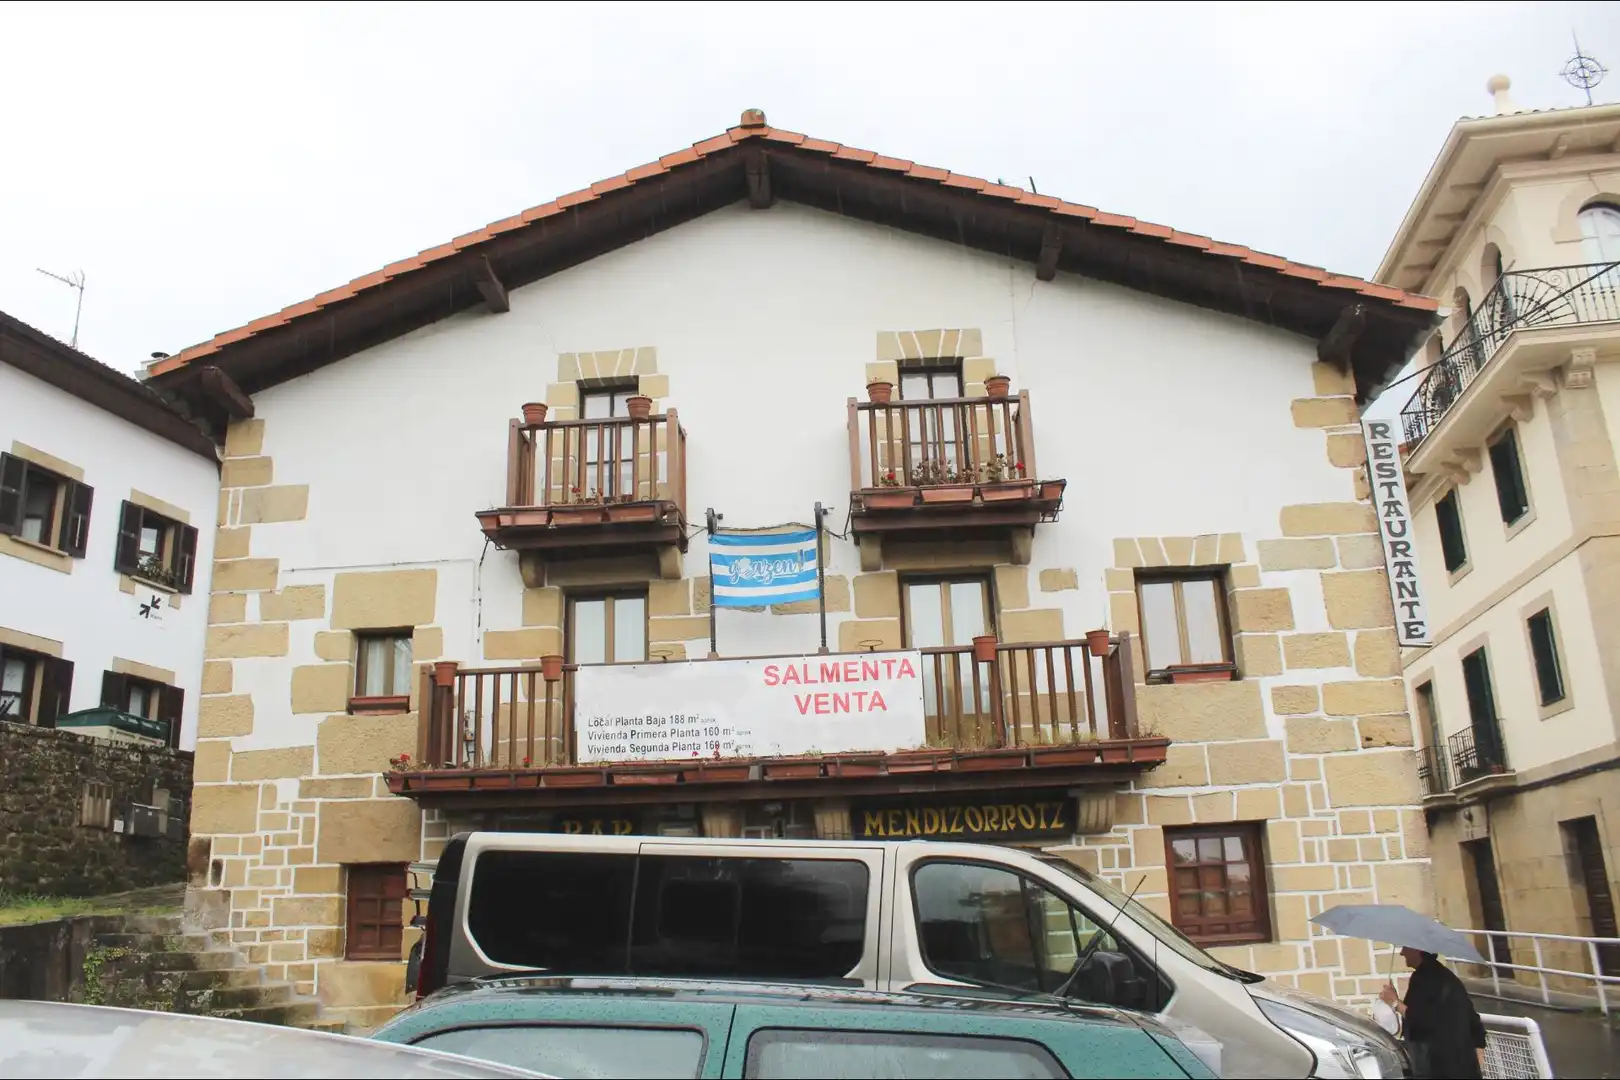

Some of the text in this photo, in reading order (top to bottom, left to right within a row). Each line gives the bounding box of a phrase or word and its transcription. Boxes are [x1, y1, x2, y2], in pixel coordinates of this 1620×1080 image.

[1367, 422, 1426, 640] RESTAURANTE
[763, 658, 917, 687] SALMENTA
[793, 690, 888, 716] VENTA
[587, 730, 628, 740] Vivienda
[630, 729, 667, 739] Primera
[670, 728, 700, 738] Planta
[703, 726, 720, 737] 160
[615, 716, 643, 727] Planta
[646, 715, 667, 727] Baja
[669, 714, 685, 724] 188
[587, 744, 627, 754] Vivienda
[629, 743, 670, 755] Segunda
[672, 741, 701, 752] Planta
[863, 802, 1066, 837] MENDIZORROTZ
